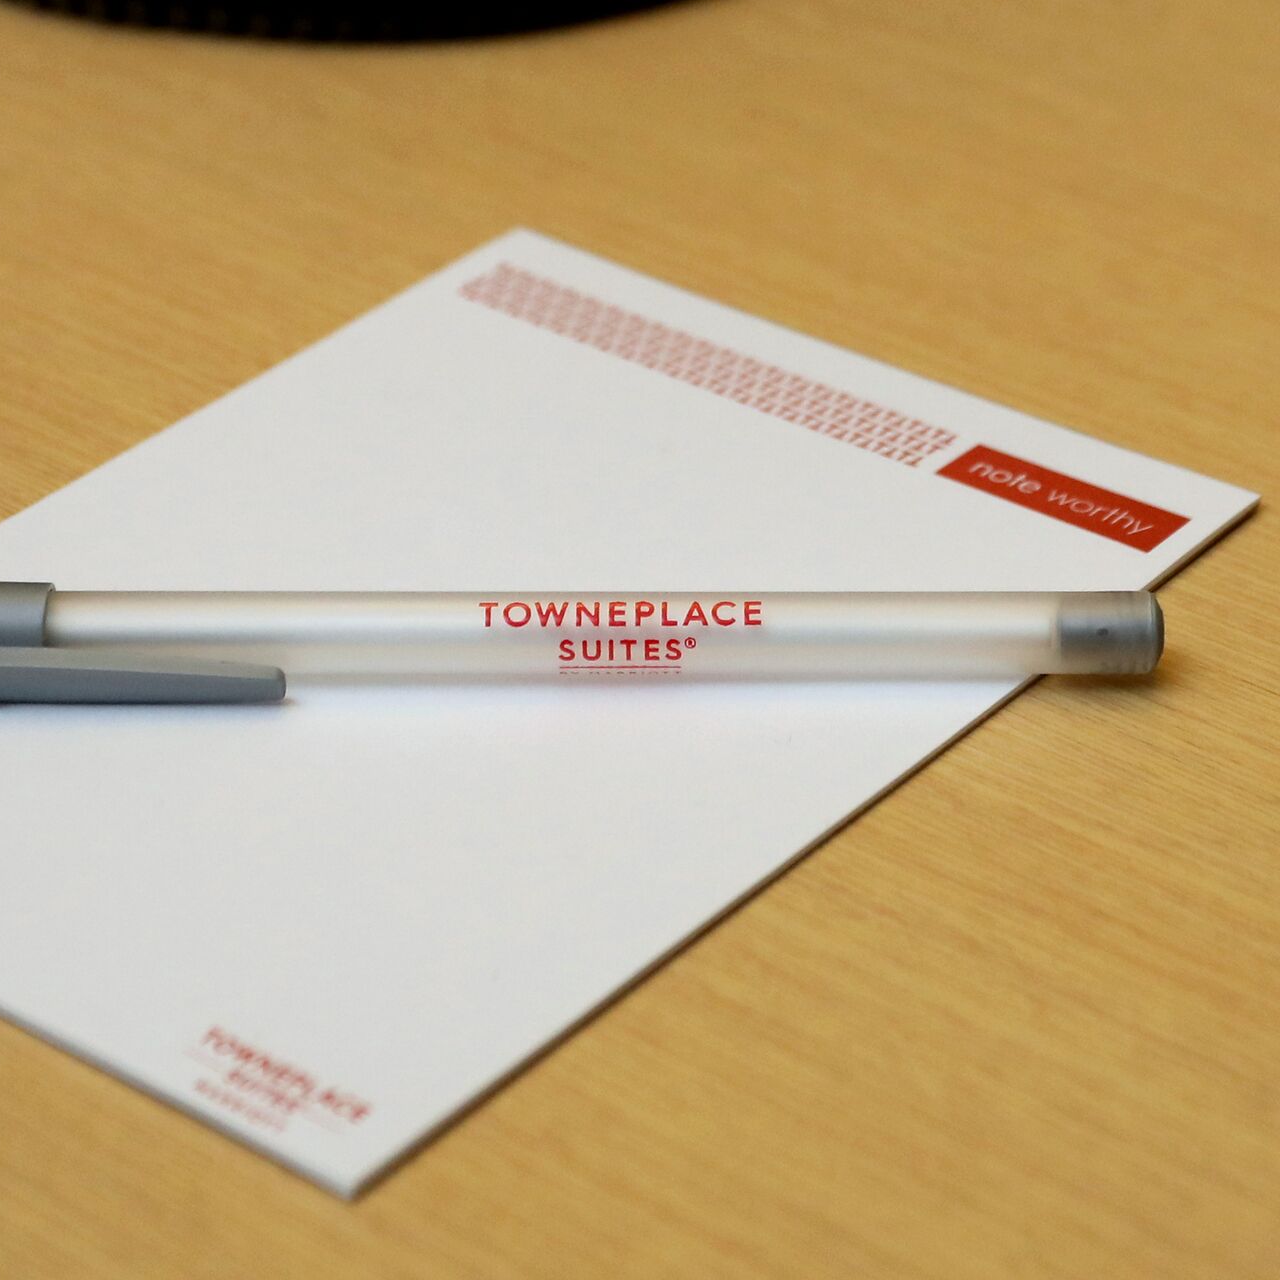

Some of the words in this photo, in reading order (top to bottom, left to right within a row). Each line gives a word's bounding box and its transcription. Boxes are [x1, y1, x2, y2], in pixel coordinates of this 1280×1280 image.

[969, 461, 1042, 495] note
[1047, 487, 1154, 536] worthy
[478, 600, 763, 628] TOWNEPLACE
